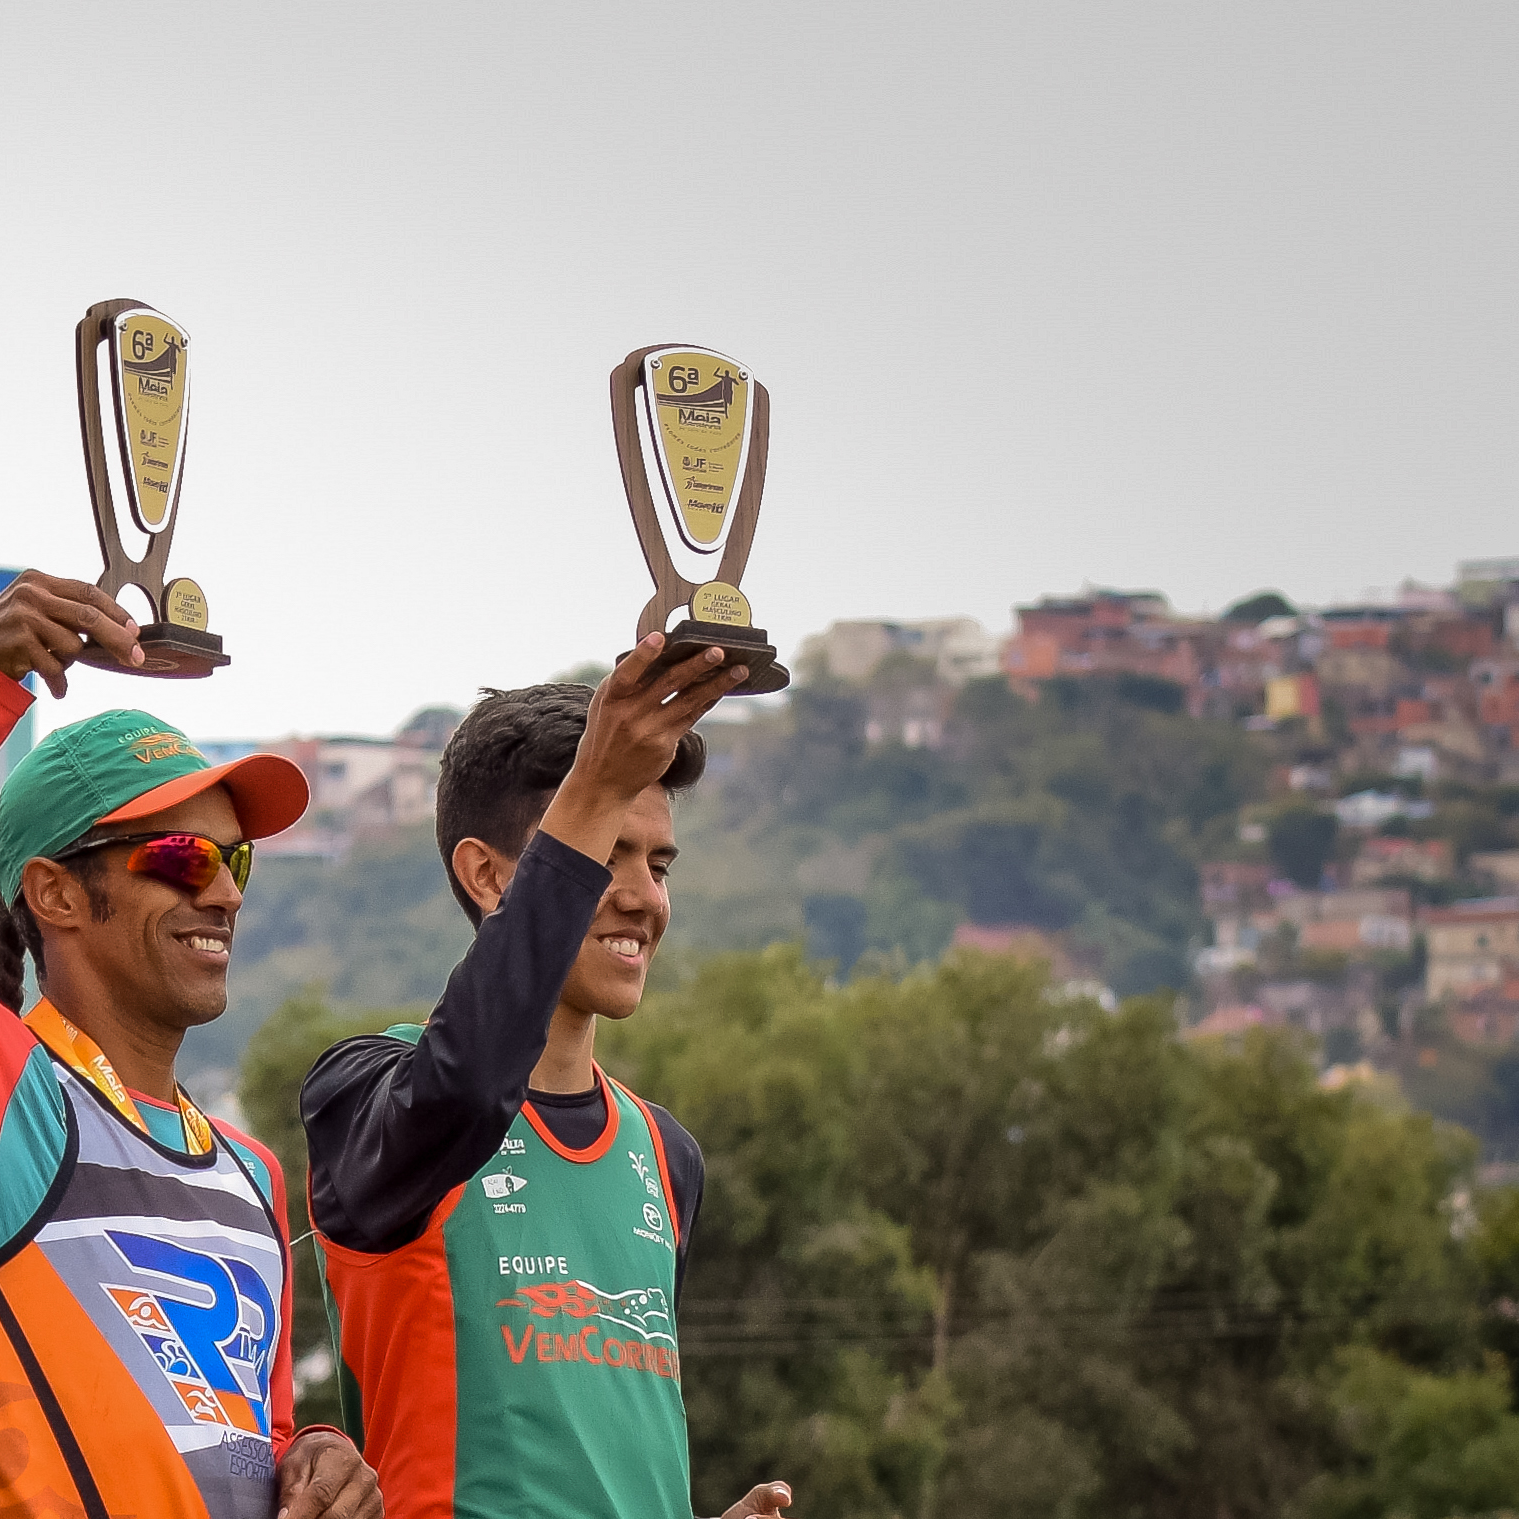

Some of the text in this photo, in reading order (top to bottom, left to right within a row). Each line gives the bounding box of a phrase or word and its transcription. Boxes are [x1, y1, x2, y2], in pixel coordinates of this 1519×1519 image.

[132, 330, 154, 361] 6ª
[668, 365, 700, 394] 6ª
[498, 1256, 569, 1276] EQUIPE
